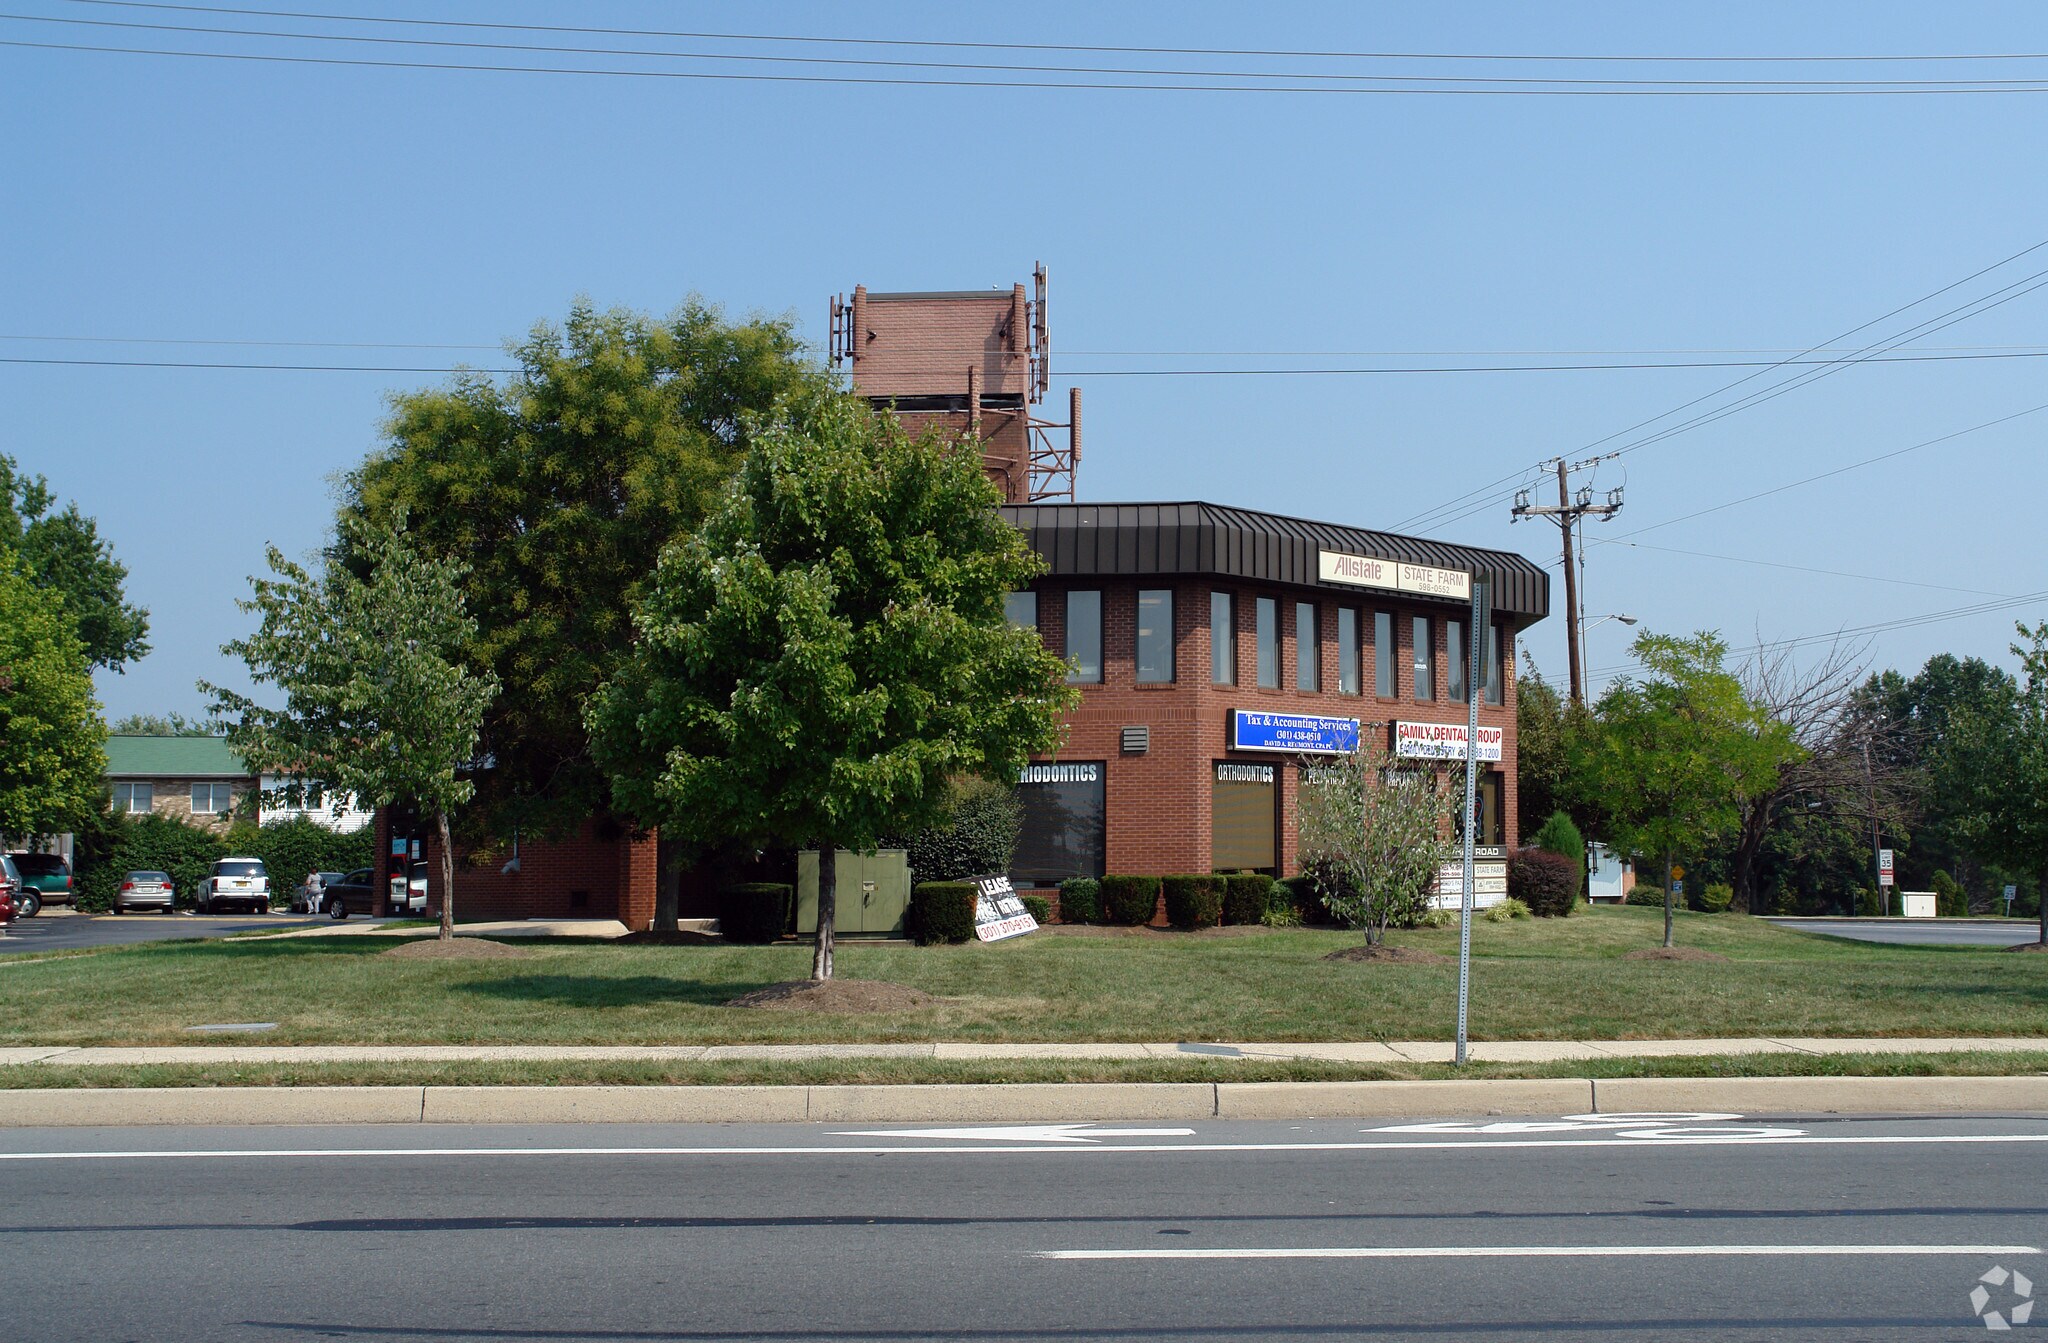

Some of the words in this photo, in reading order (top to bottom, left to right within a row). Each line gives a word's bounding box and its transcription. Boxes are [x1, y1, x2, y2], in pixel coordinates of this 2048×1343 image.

[1334, 556, 1382, 580] Allstate
[1404, 566, 1433, 583] STATE
[1438, 571, 1464, 587] FARM
[1418, 582, 1450, 594] 598-0552
[1246, 714, 1261, 726] Tax
[1263, 715, 1271, 727] &
[1272, 716, 1318, 732] Accounting
[1319, 719, 1351, 731] Services
[1276, 730, 1292, 740] (301)
[1293, 730, 1321, 741] 438-0510
[1398, 724, 1431, 740] FAMILY
[1433, 726, 1468, 742] DENTAL
[1477, 729, 1501, 743] ROUP
[1018, 764, 1097, 783] RIODONTICS
[1217, 764, 1274, 783] ORTHODONTICS
[1475, 847, 1499, 856] ROAD
[1476, 866, 1490, 874] STATE
[1490, 865, 1505, 873] FARM
[1881, 859, 1892, 867] 35
[979, 876, 1013, 896] LEASE
[977, 924, 1001, 941] (301)
[1000, 916, 1036, 934] 370-9151
